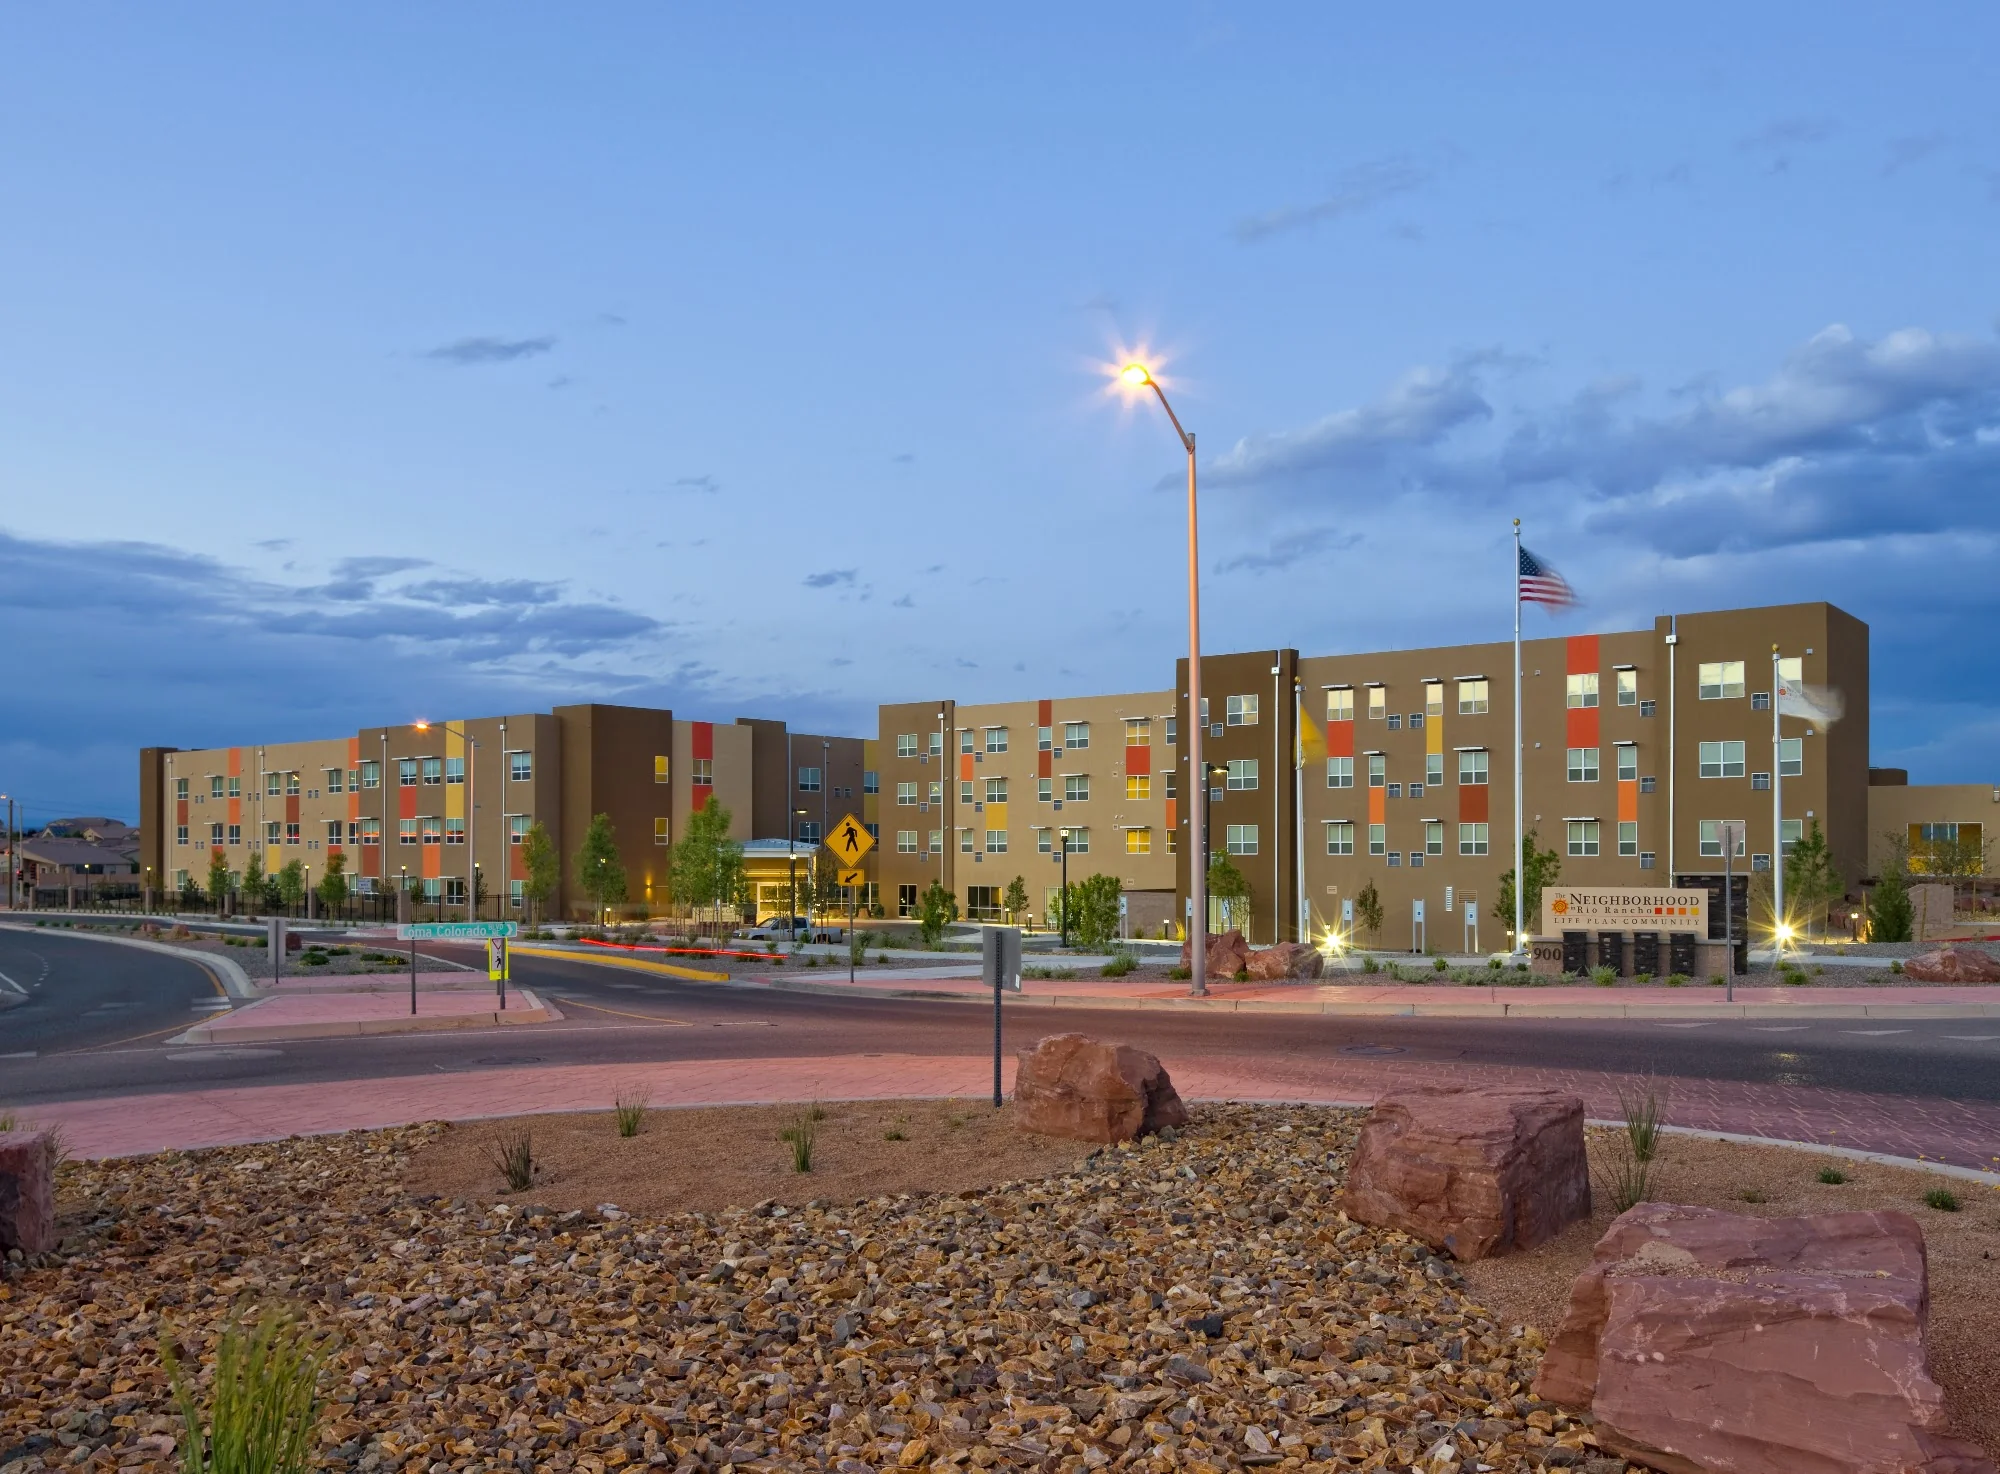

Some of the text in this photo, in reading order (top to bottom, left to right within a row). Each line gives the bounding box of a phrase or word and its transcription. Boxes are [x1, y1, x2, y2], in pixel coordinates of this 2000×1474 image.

[1570, 894, 1699, 906] NEIGHBORHOOD
[436, 924, 486, 936] Colorado
[1534, 948, 1562, 961] 900
